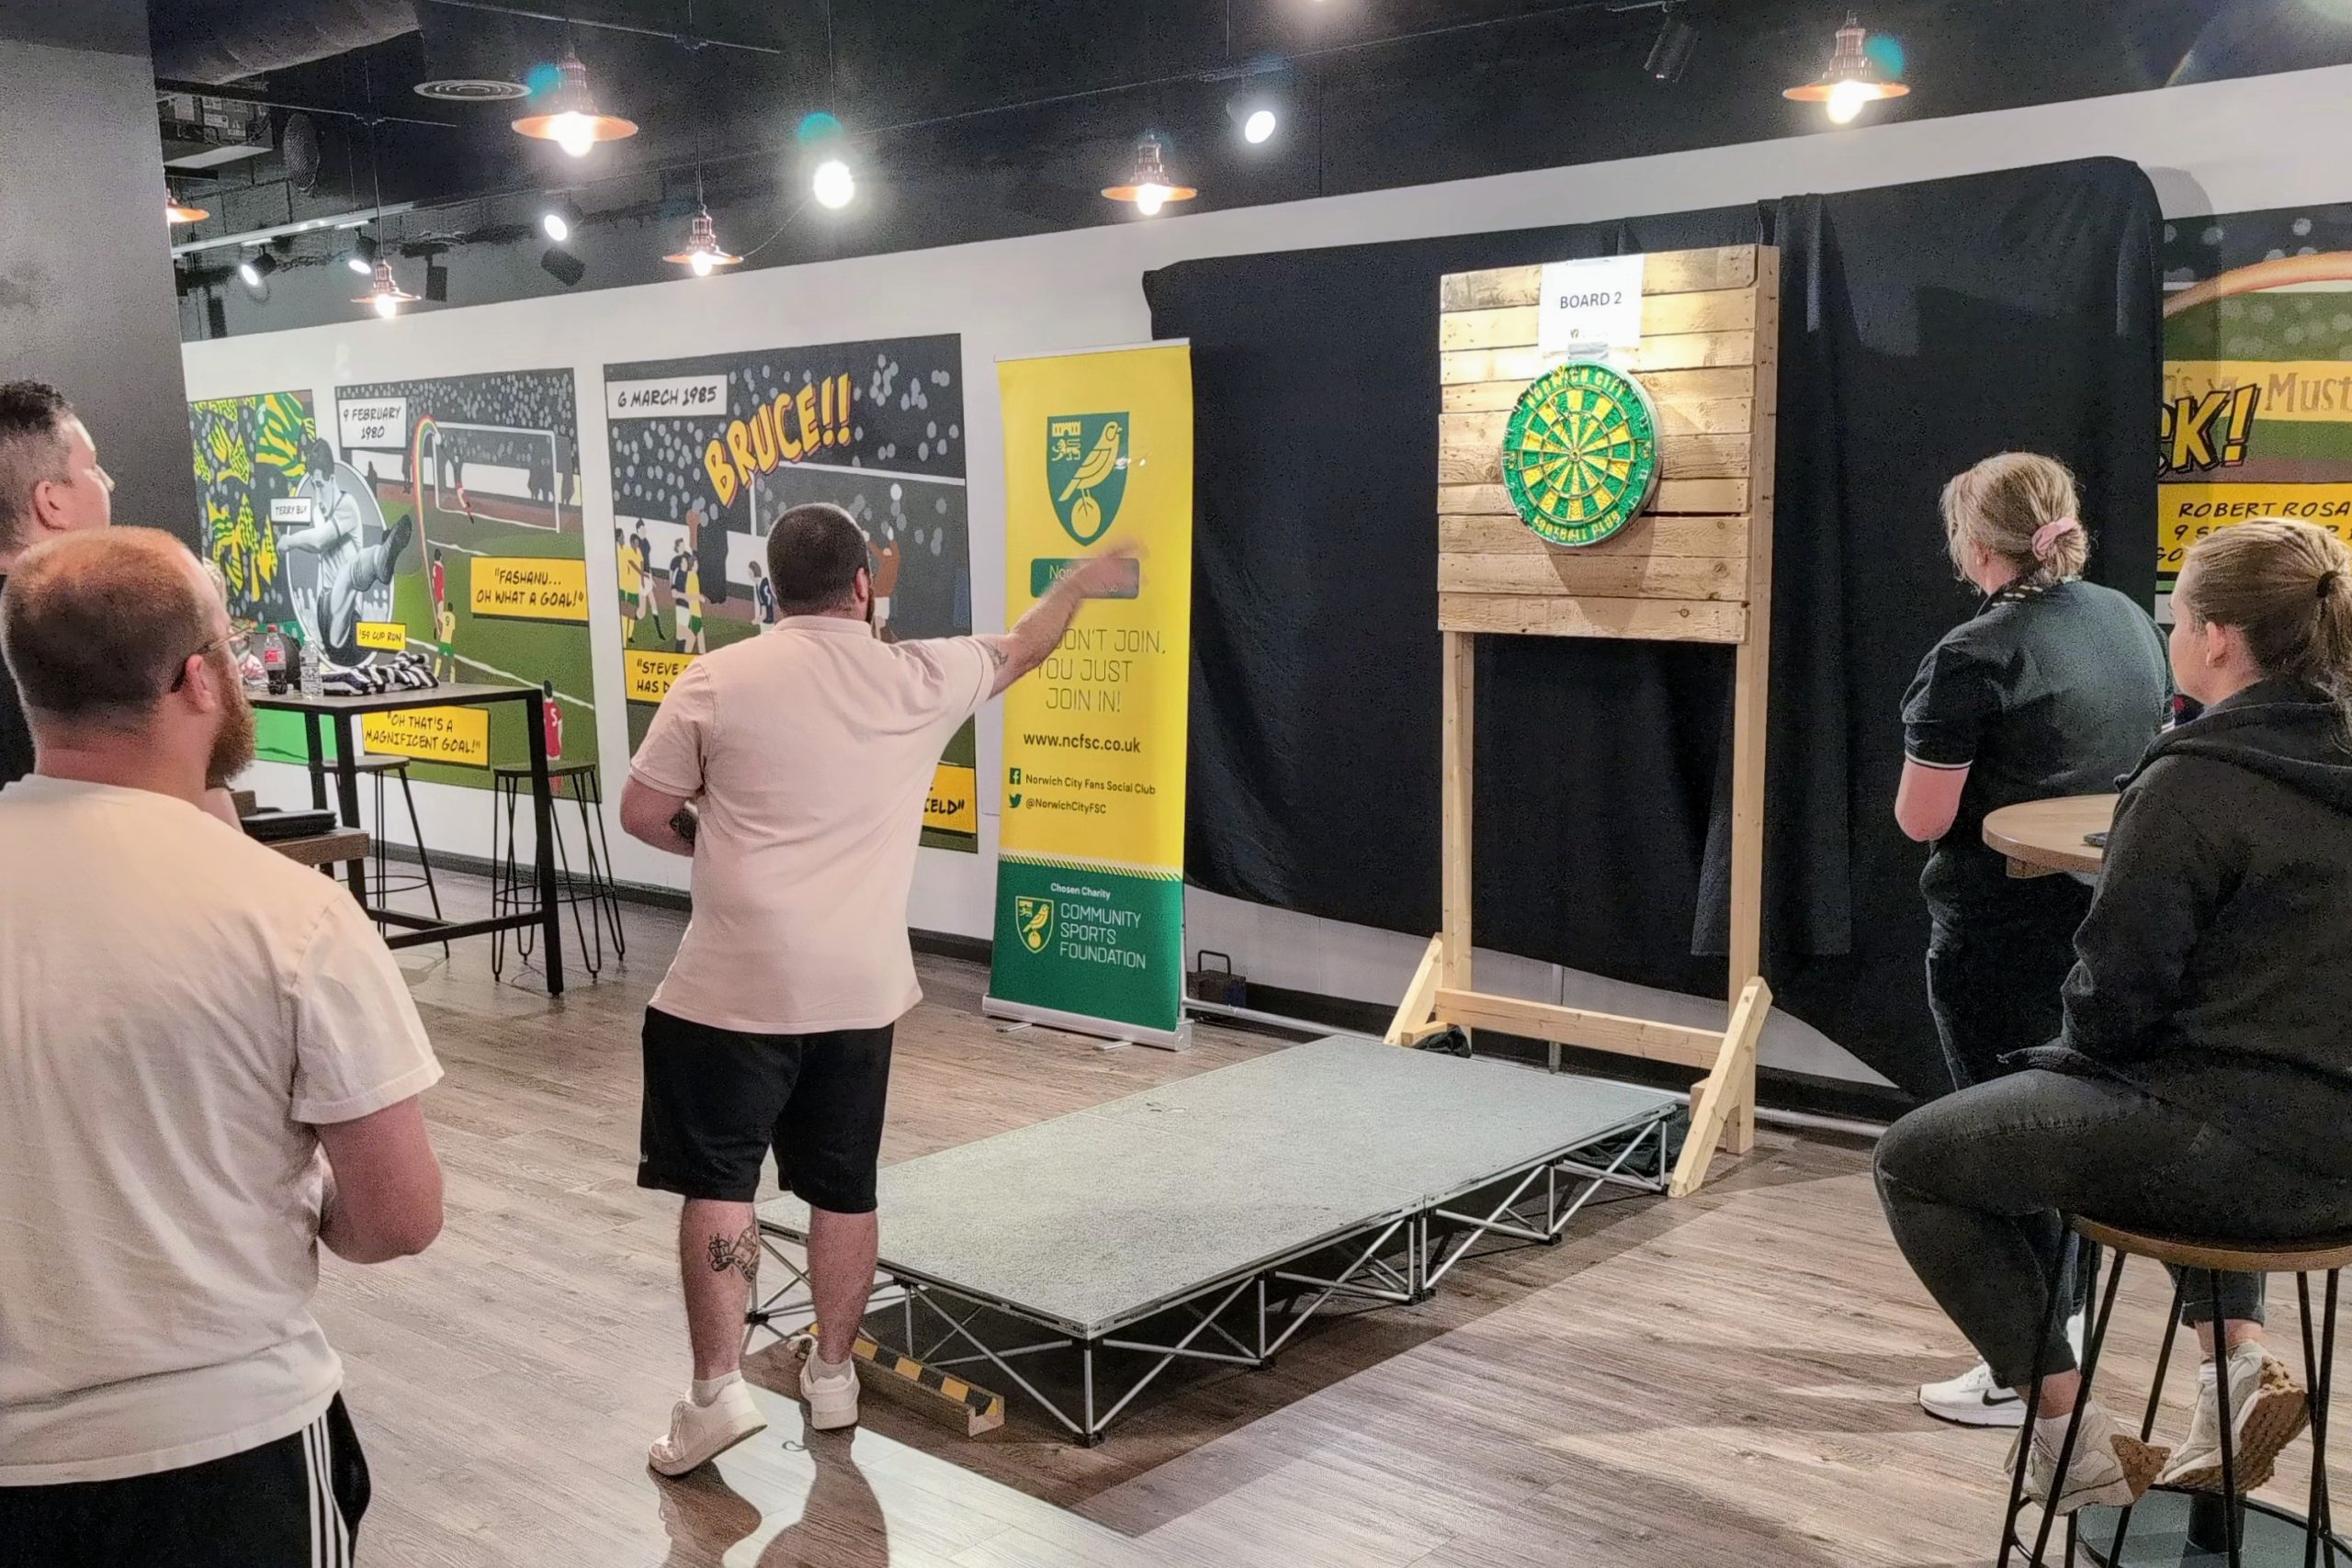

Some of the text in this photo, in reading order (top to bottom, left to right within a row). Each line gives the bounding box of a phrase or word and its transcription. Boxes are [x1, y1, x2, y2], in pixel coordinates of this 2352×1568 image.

[1560, 291, 1622, 309] BOARD 2
[1595, 370, 1625, 398] CITY
[617, 386, 718, 408] 6 MARCH 1985
[343, 406, 401, 422] 9 FEBRUARY
[361, 425, 385, 440] 1980
[705, 372, 852, 508] BRUCE!!
[276, 505, 295, 515] TERRY
[2178, 502, 2278, 519] ROBERT
[2174, 525, 2188, 541] 9
[476, 589, 492, 604] OH
[495, 591, 526, 604] WHAT
[528, 591, 537, 605] A
[445, 615, 450, 626] 9
[372, 631, 386, 641] CUP
[387, 631, 402, 642] RUN
[1114, 628, 1166, 655] JOIN,
[637, 658, 679, 676] "STEVE
[1080, 659, 1133, 683] JUST
[637, 679, 659, 694] HAS
[1046, 687, 1121, 713] JOIN IN!
[408, 716, 444, 731] THAT'S
[446, 719, 454, 733] A
[365, 728, 439, 750] MAGNIFICENT
[1023, 733, 1141, 753] www.ncfsc.co.uk
[1025, 773, 1156, 795] Norwich City Fans Social Club
[1025, 797, 1107, 815] @NorwichCityFSC
[1050, 882, 1111, 901] Chosen Charity
[1060, 902, 1142, 929] COMMUNITY
[1060, 922, 1116, 944] SPORTS
[1059, 942, 1147, 970] FOUNDATION
